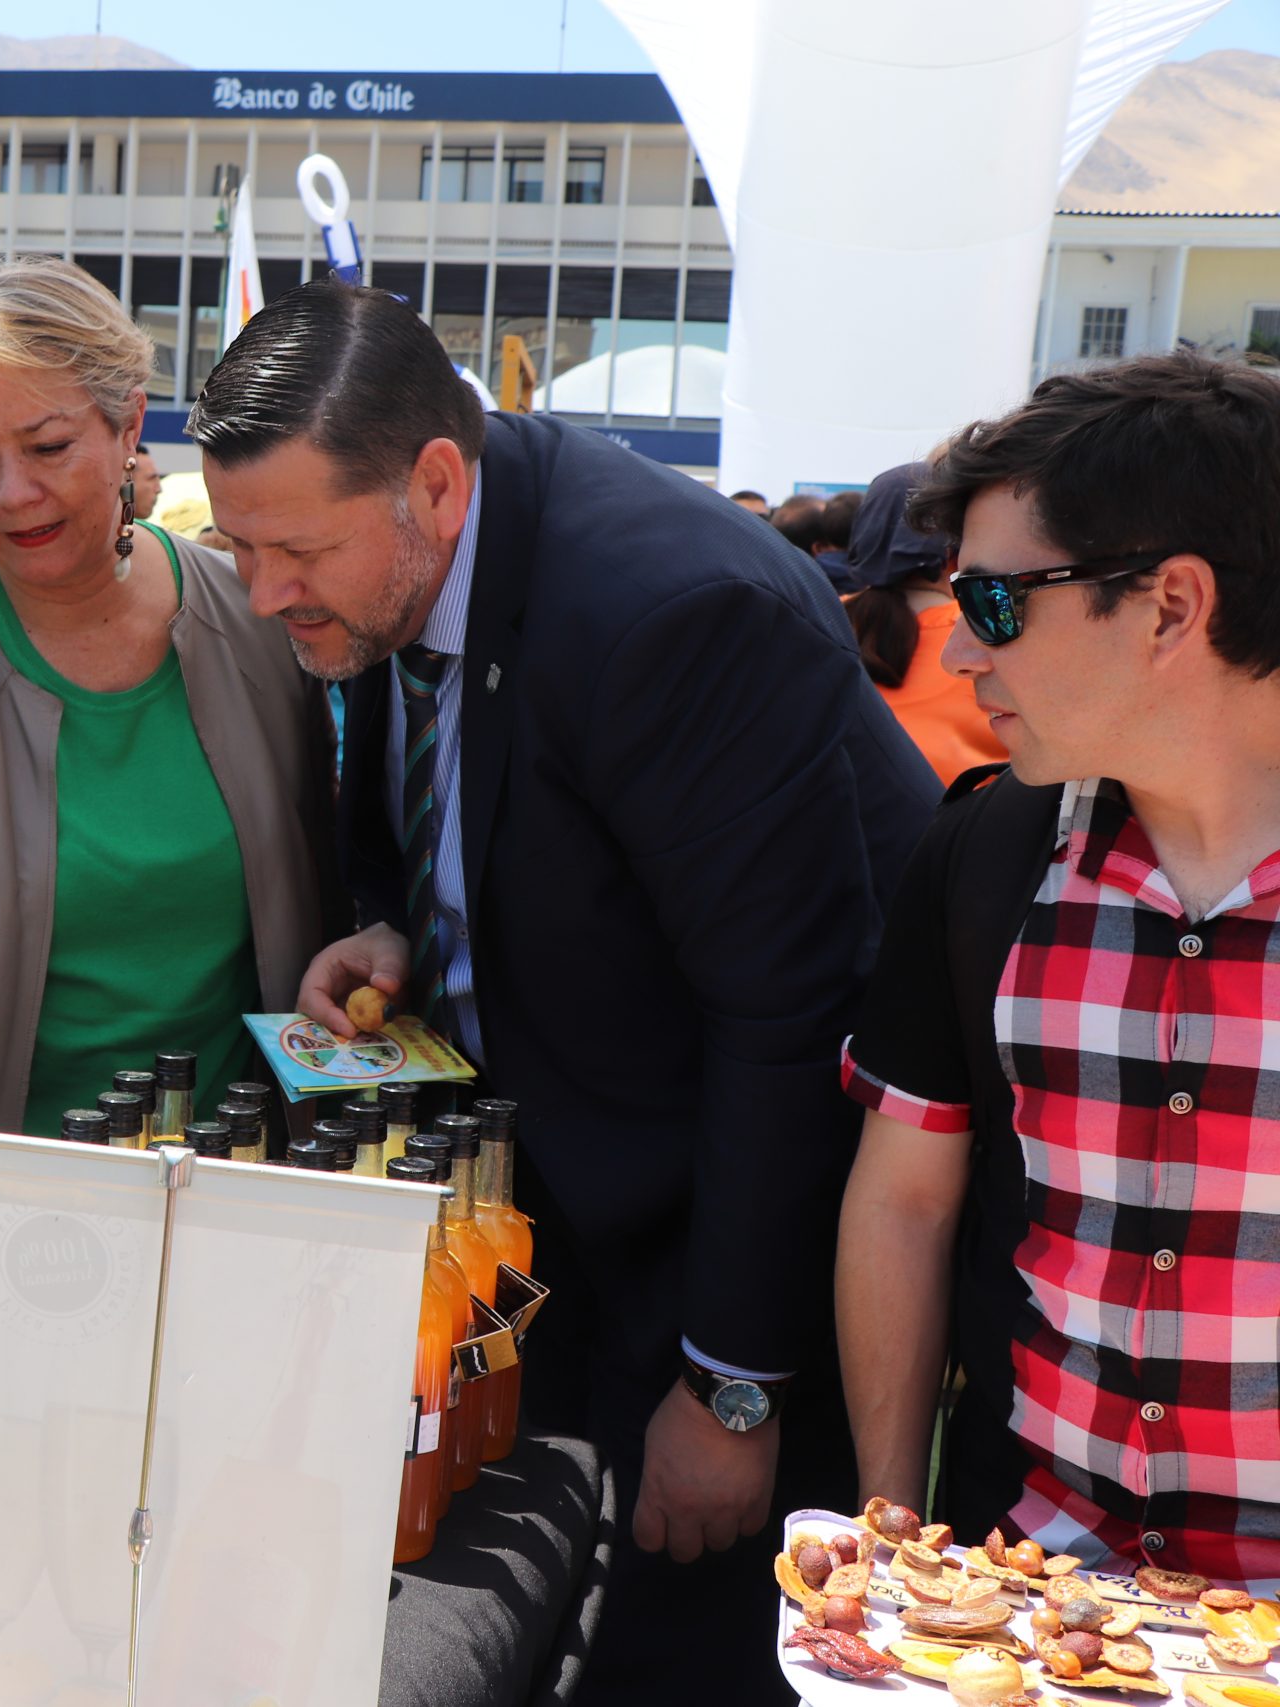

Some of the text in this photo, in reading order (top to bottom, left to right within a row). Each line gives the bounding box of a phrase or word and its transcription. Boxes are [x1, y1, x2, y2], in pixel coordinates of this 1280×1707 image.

[213, 77, 415, 113] Banco de Chile
[1171, 1651, 1210, 1669] PICA
